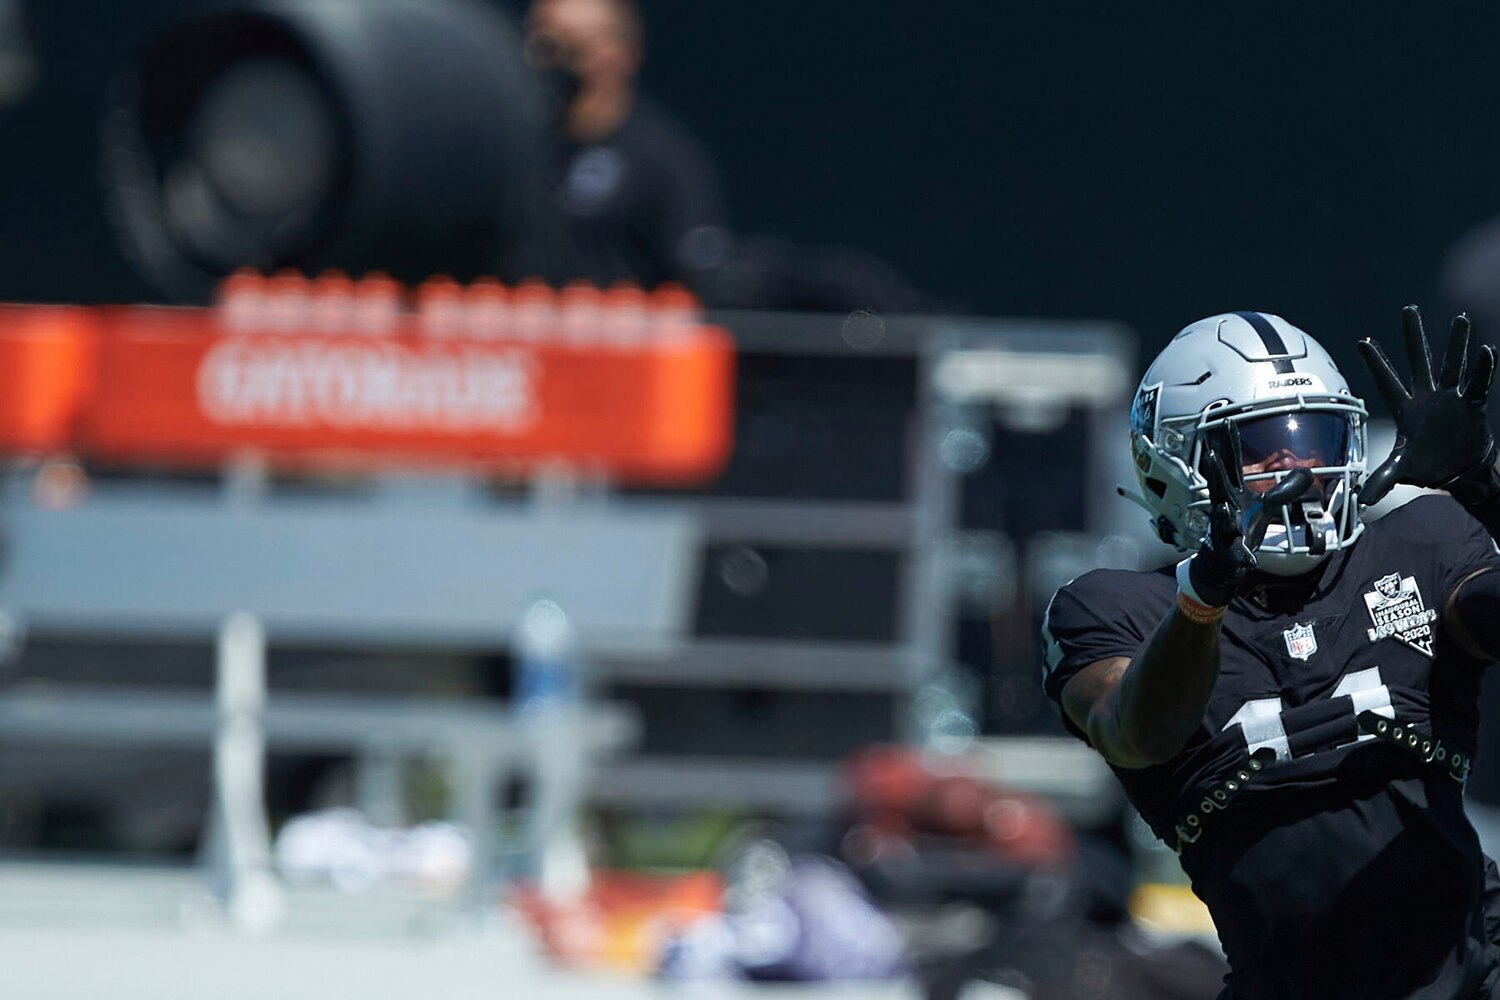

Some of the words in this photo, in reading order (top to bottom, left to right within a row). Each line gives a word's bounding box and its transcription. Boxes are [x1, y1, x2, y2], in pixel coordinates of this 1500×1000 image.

[1375, 598, 1419, 619] INAUGURAL
[1376, 604, 1421, 626] SEASON
[1402, 624, 1431, 642] 2020
